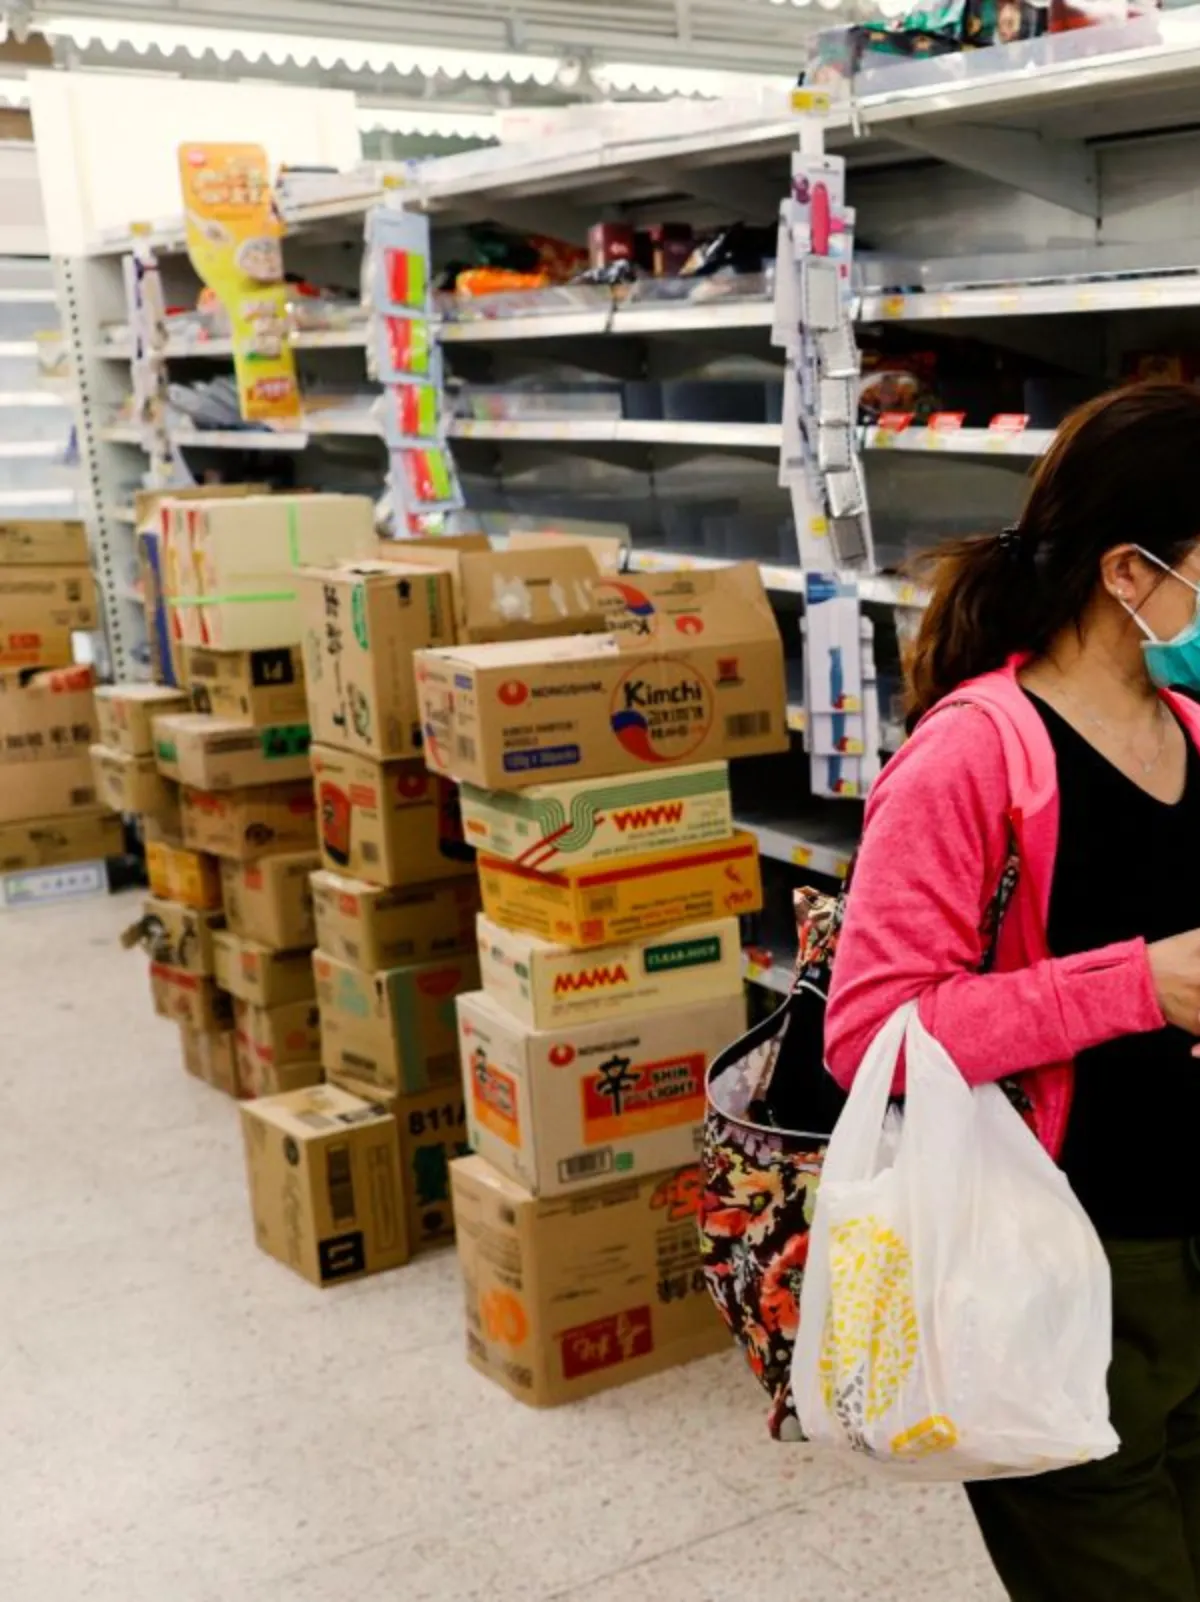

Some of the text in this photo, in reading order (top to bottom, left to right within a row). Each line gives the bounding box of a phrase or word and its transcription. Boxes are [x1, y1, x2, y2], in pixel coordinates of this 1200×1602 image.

[624, 681, 702, 708] Kimchi
[554, 966, 628, 993] MAMA
[596, 1055, 641, 1115] 辛
[652, 1067, 689, 1083] SHIN
[648, 1081, 696, 1100] LIGHT
